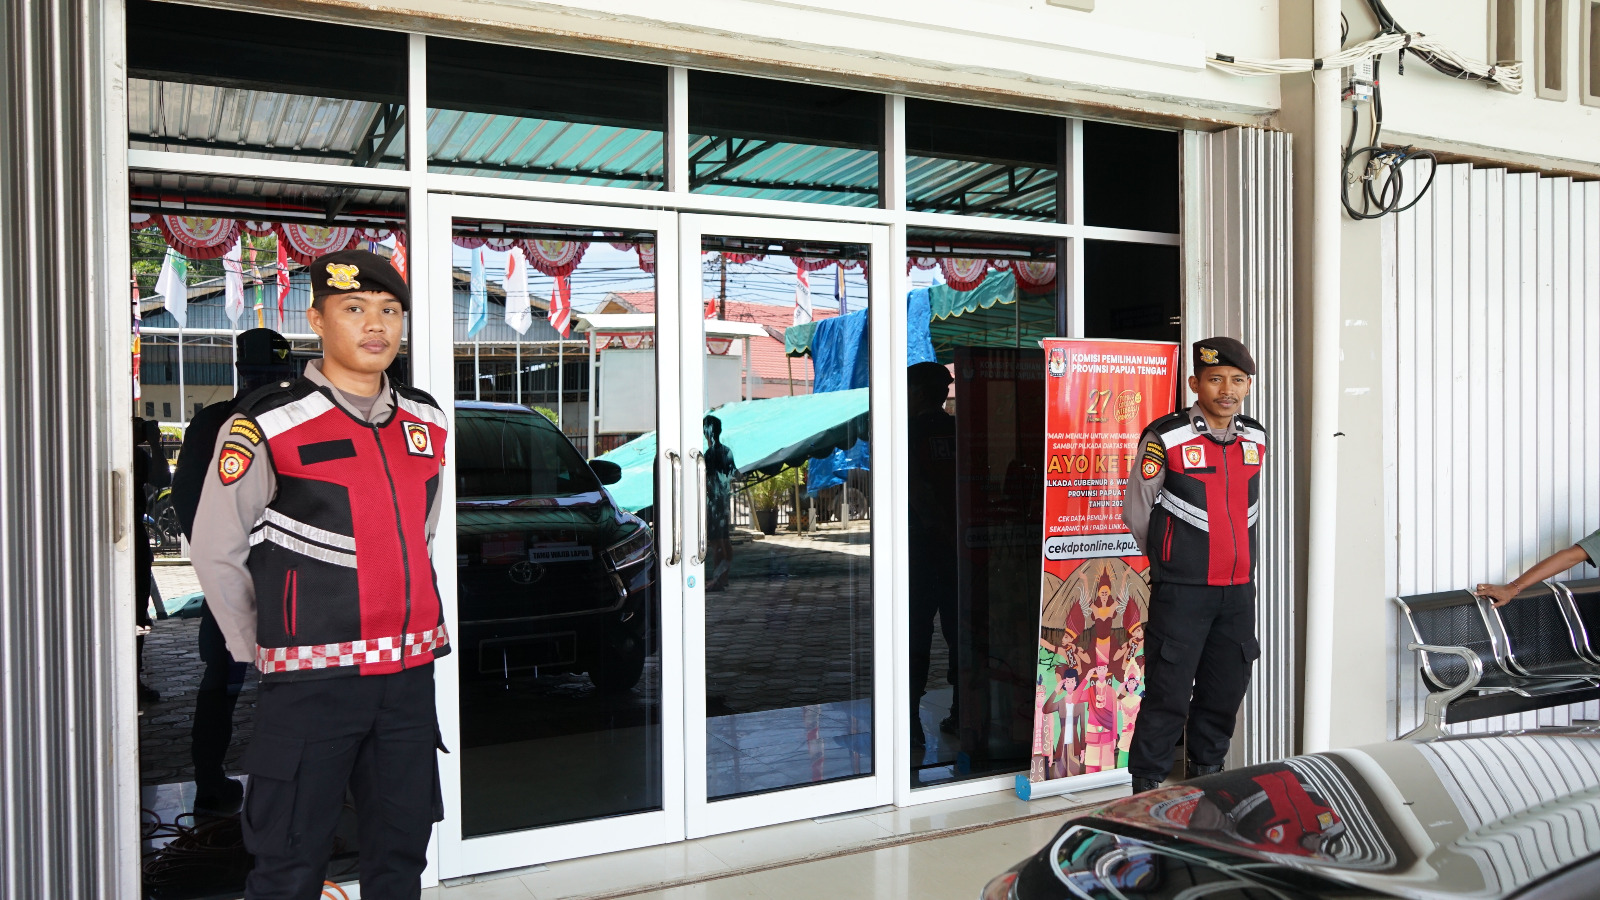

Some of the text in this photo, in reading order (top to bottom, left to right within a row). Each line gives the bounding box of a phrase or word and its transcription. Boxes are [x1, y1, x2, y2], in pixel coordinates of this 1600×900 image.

[1072, 354, 1167, 365] KOMISI PEMILIHAN UMUM
[1072, 363, 1167, 375] PROVINSI PAPUA TENGAH
[1086, 388, 1113, 415] 27
[1090, 432, 1109, 440] UNTUK
[1109, 432, 1141, 440] MEMBANG
[1052, 442, 1078, 450] SAMBUT
[1047, 454, 1090, 474] AYO
[1094, 454, 1119, 473] KE
[1046, 479, 1073, 488] ILKADA
[1073, 479, 1108, 487] GUBERNUR
[1068, 489, 1098, 498] PROVINSI
[1099, 489, 1122, 497] PAPUA
[1089, 500, 1110, 508] TAHUN
[1058, 515, 1070, 523] CEK
[1049, 524, 1080, 533] SEKARANG
[1048, 540, 1142, 555] cekdptonline.kpu.
